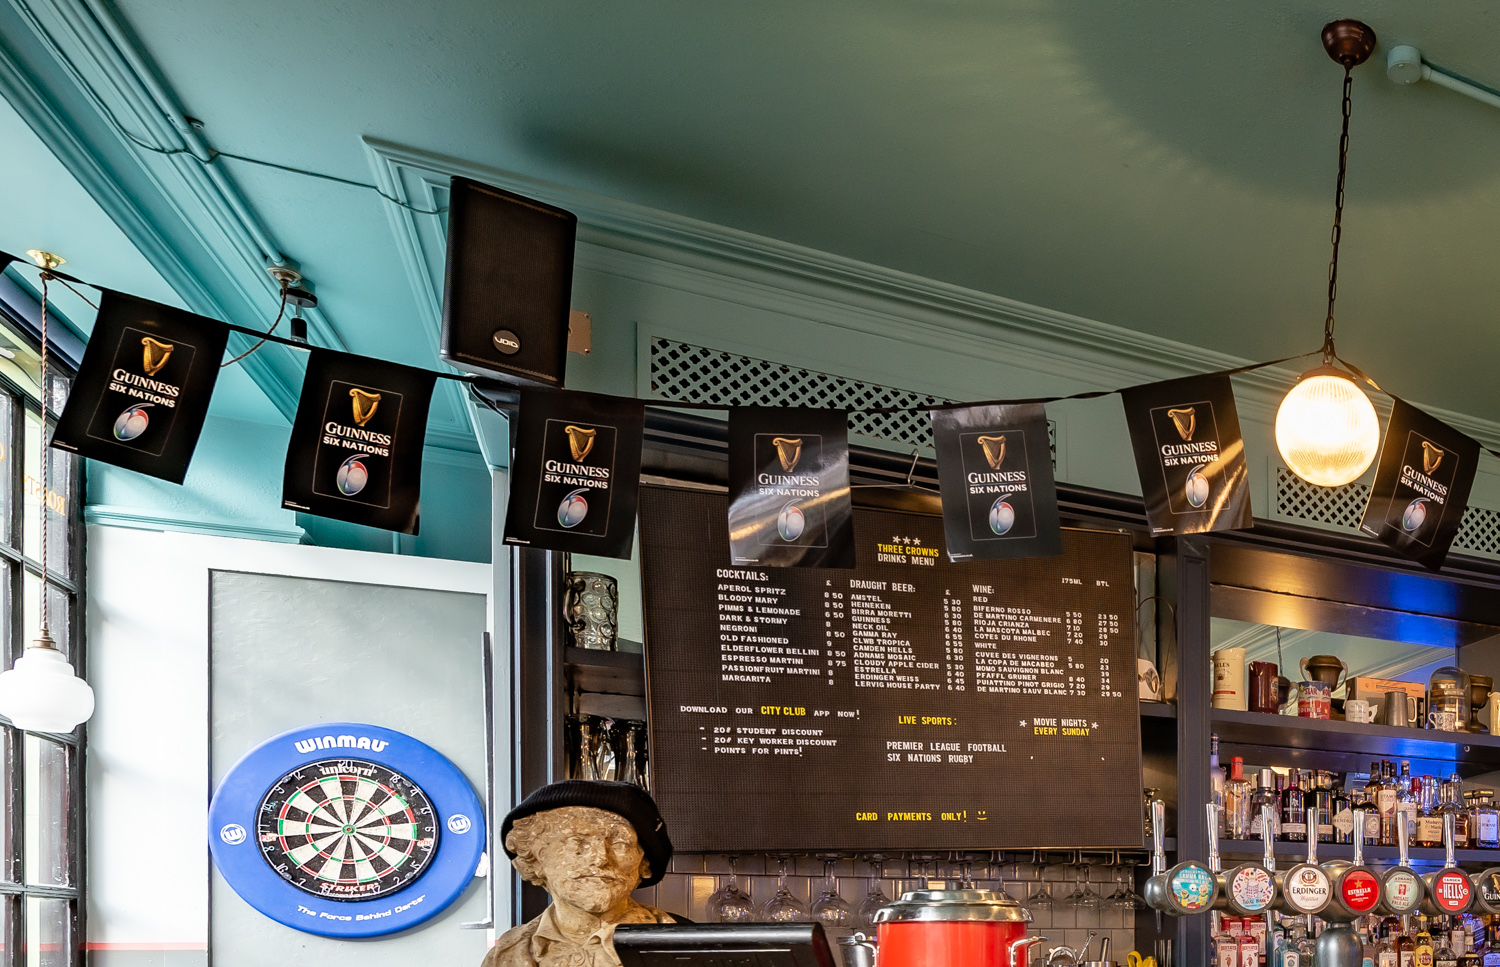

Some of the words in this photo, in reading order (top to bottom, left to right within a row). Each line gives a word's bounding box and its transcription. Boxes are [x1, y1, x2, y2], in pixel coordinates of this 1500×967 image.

[113, 368, 179, 398] GUINNESS
[109, 382, 127, 394] SIX
[128, 388, 175, 408] NATIONS
[325, 422, 391, 446] GUINNESS
[323, 436, 340, 446] SIX
[342, 440, 389, 456] NATIONS
[1161, 441, 1217, 456] GUINNESS
[1164, 458, 1179, 466] SIX
[1181, 454, 1219, 465] NATIONS
[545, 460, 610, 478] GUINNESS
[544, 474, 561, 484] SIX
[563, 476, 608, 489] NATIONS
[758, 473, 820, 486] GUINNESS
[968, 471, 1026, 484] GUINNESS
[1403, 465, 1448, 496] GUINNESS
[759, 488, 774, 496] SIX
[777, 488, 820, 498] NATIONS
[970, 485, 984, 494] SIX
[986, 484, 1027, 493] NATIONS
[1400, 476, 1413, 487] SIX
[1413, 483, 1445, 505] NATIONS
[878, 544, 903, 554] THREE
[906, 547, 939, 557] CROWNS
[878, 554, 906, 563] DRINKS
[912, 557, 934, 566] MENU
[717, 569, 769, 581] COCKTAILS:
[718, 584, 752, 592] APEROL
[755, 587, 786, 595] SPRITZ
[850, 580, 886, 590] DRAUGHT
[892, 583, 915, 592] BEER:
[972, 584, 994, 594] WINE:
[718, 594, 752, 602] BLOODY
[851, 594, 882, 602] AMSTEL
[756, 607, 800, 616] LEMONADE
[741, 636, 789, 644] FASHIONED
[721, 645, 783, 654] ELDERFLOWER
[722, 655, 767, 663] ESPRESSO
[722, 665, 784, 673] PASSIONFRUIT
[761, 706, 781, 716] CITY
[783, 707, 806, 716] CLUB
[838, 710, 860, 720] NOW!
[898, 716, 917, 725] LIVE
[922, 717, 957, 725] SPORTS:
[1034, 718, 1057, 727] MOVIE
[1061, 719, 1087, 727] NIGHTS
[737, 727, 776, 735] STUDENT
[1034, 727, 1057, 735] EVERY
[1062, 727, 1090, 736] SUNDAY
[294, 735, 389, 753] WINMAU
[887, 742, 923, 750] PREMIER
[930, 743, 961, 751] LEAGUE
[968, 744, 1006, 752] FOOTBALL
[775, 747, 802, 756] PINTS!
[887, 754, 900, 762] SIX
[908, 754, 941, 762] NATIONS
[949, 755, 973, 764] RUGBY
[320, 766, 377, 777] unicorn
[856, 813, 878, 821] CARD
[888, 813, 932, 821] PAYMENTS
[941, 810, 967, 822] ONLY!
[319, 882, 378, 892] STRIKER
[1293, 887, 1326, 895] ERDINGER
[1347, 887, 1371, 895] ESTRELLA
[1443, 884, 1463, 899] HELLS
[297, 905, 316, 917] The
[319, 911, 352, 921] Force
[356, 909, 392, 921] Behind
[395, 895, 426, 913] Darts
